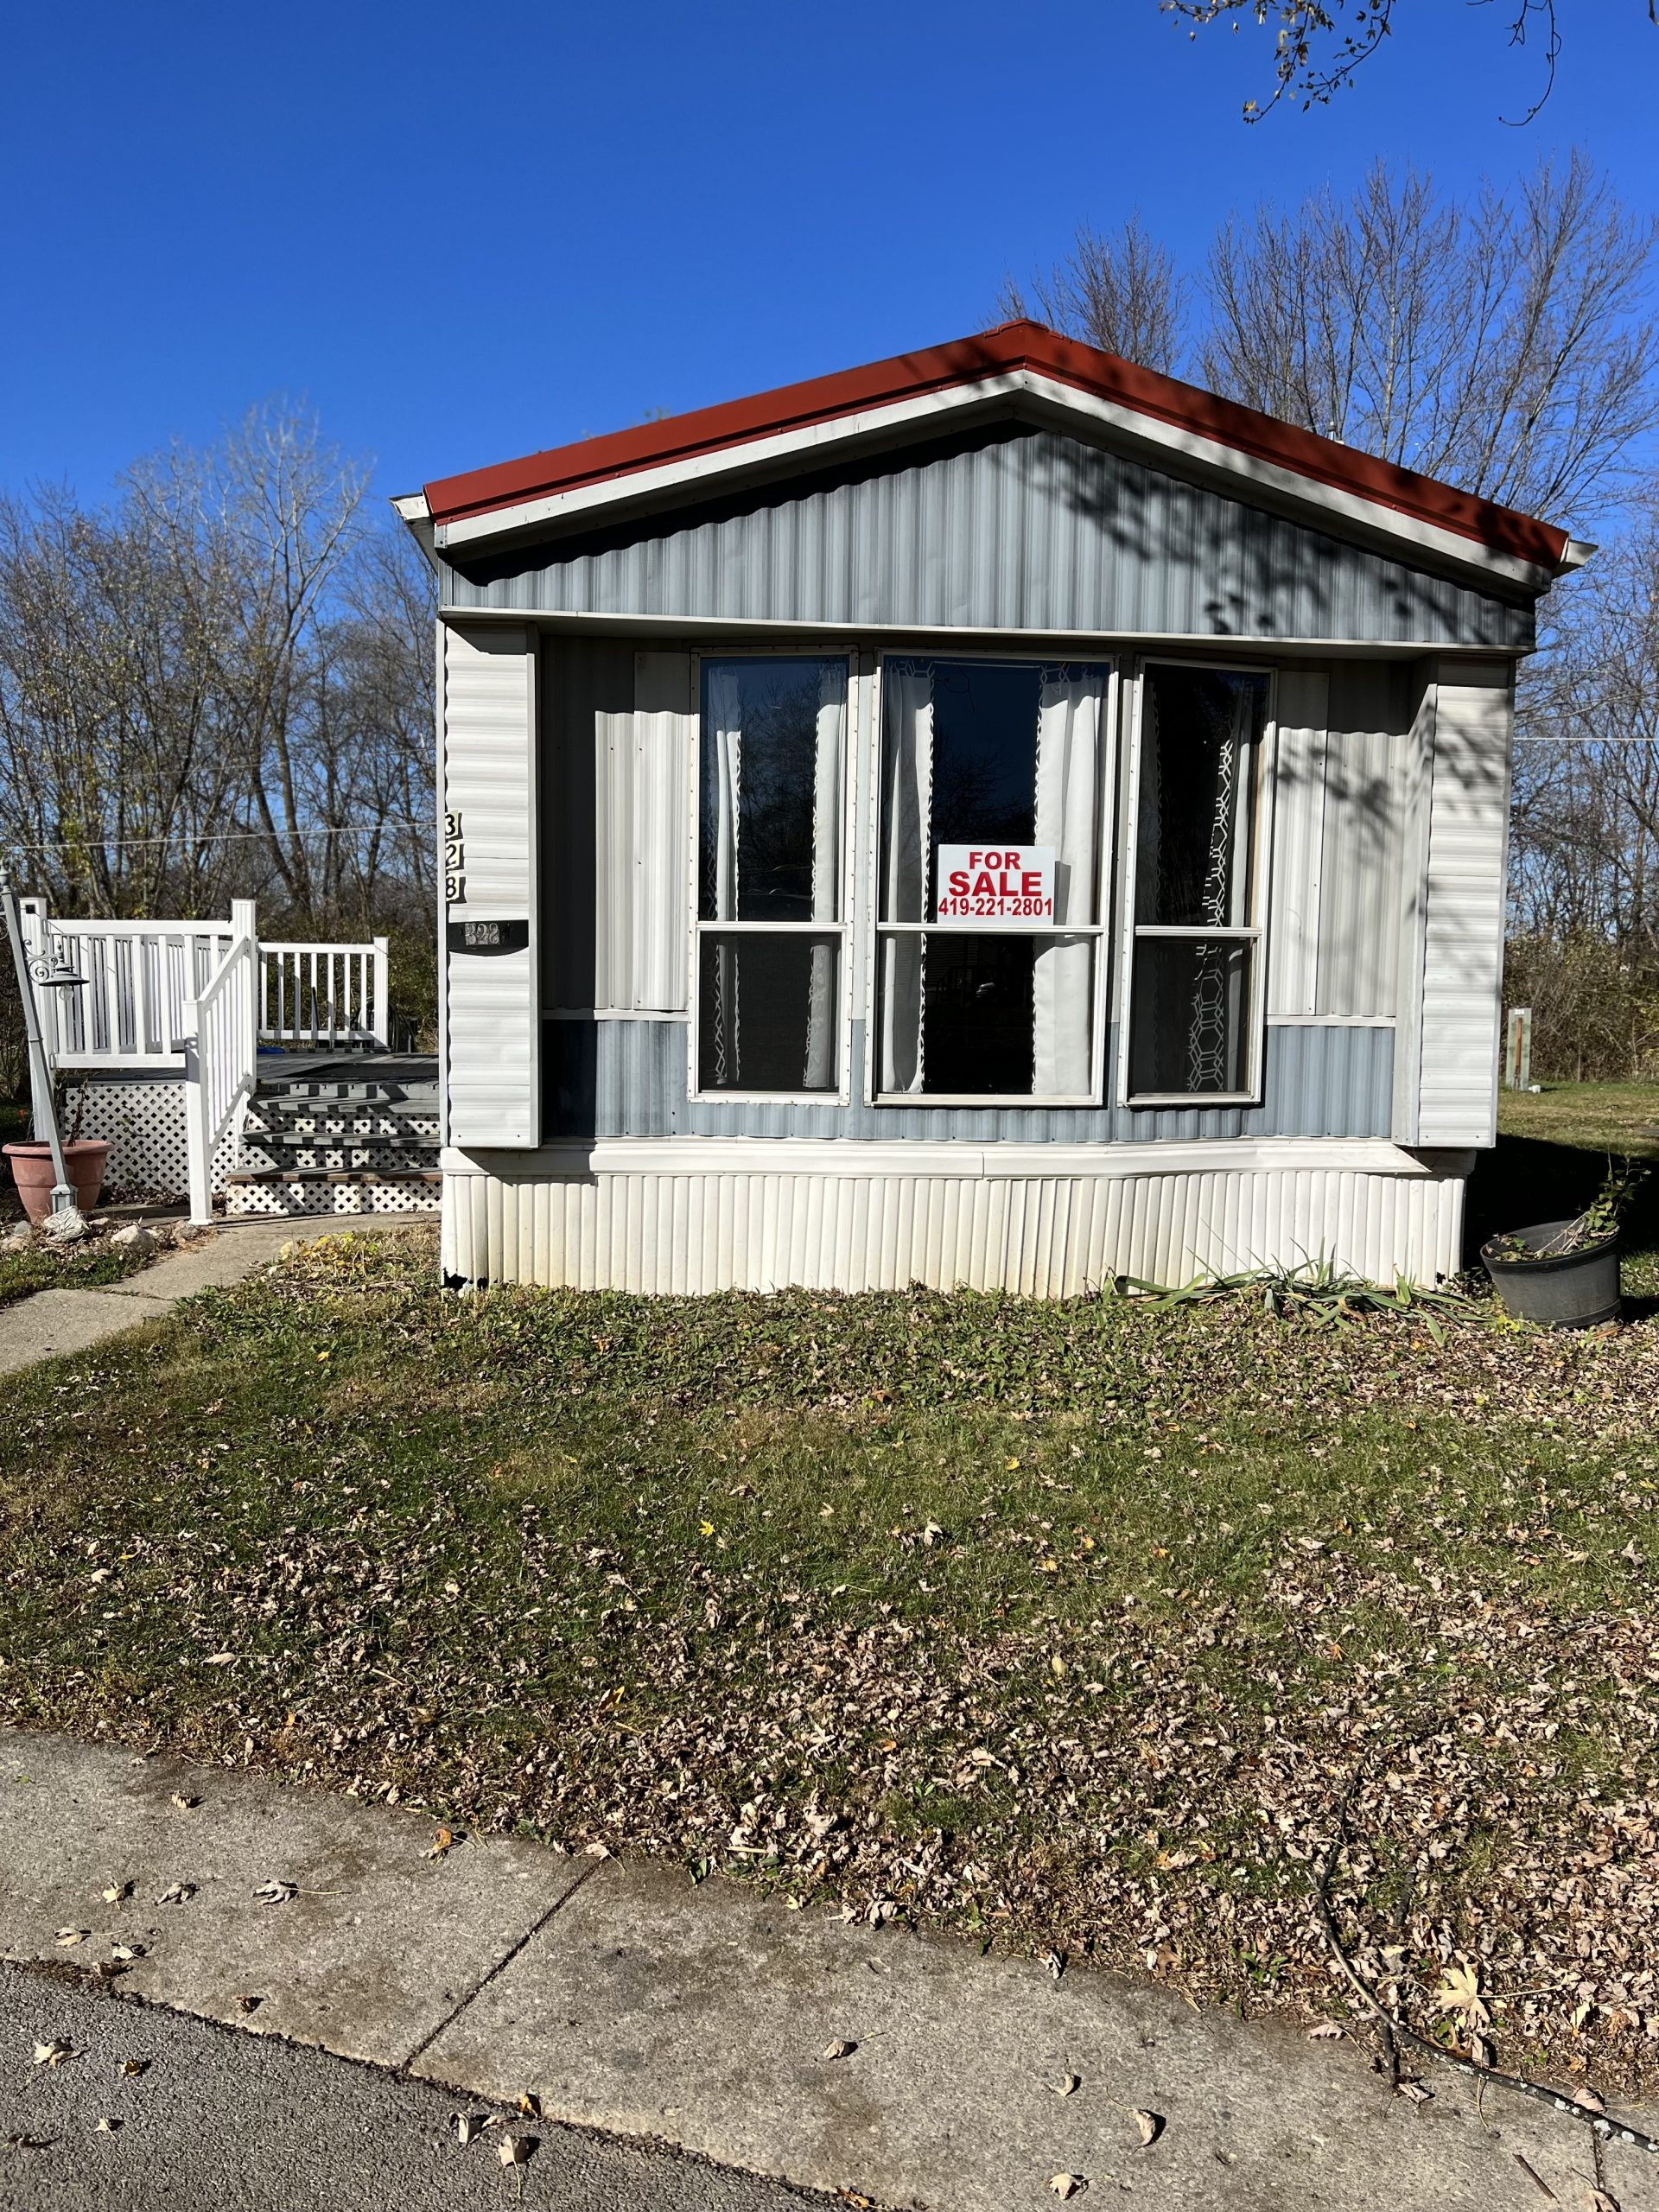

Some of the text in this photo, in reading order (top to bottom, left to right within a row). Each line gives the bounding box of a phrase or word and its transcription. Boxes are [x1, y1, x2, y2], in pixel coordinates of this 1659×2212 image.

[444, 813, 457, 899] 328
[969, 851, 1021, 870] FOR
[948, 871, 1042, 897] SALE
[938, 898, 1052, 916] 419-221-2801
[465, 923, 499, 945] 328
